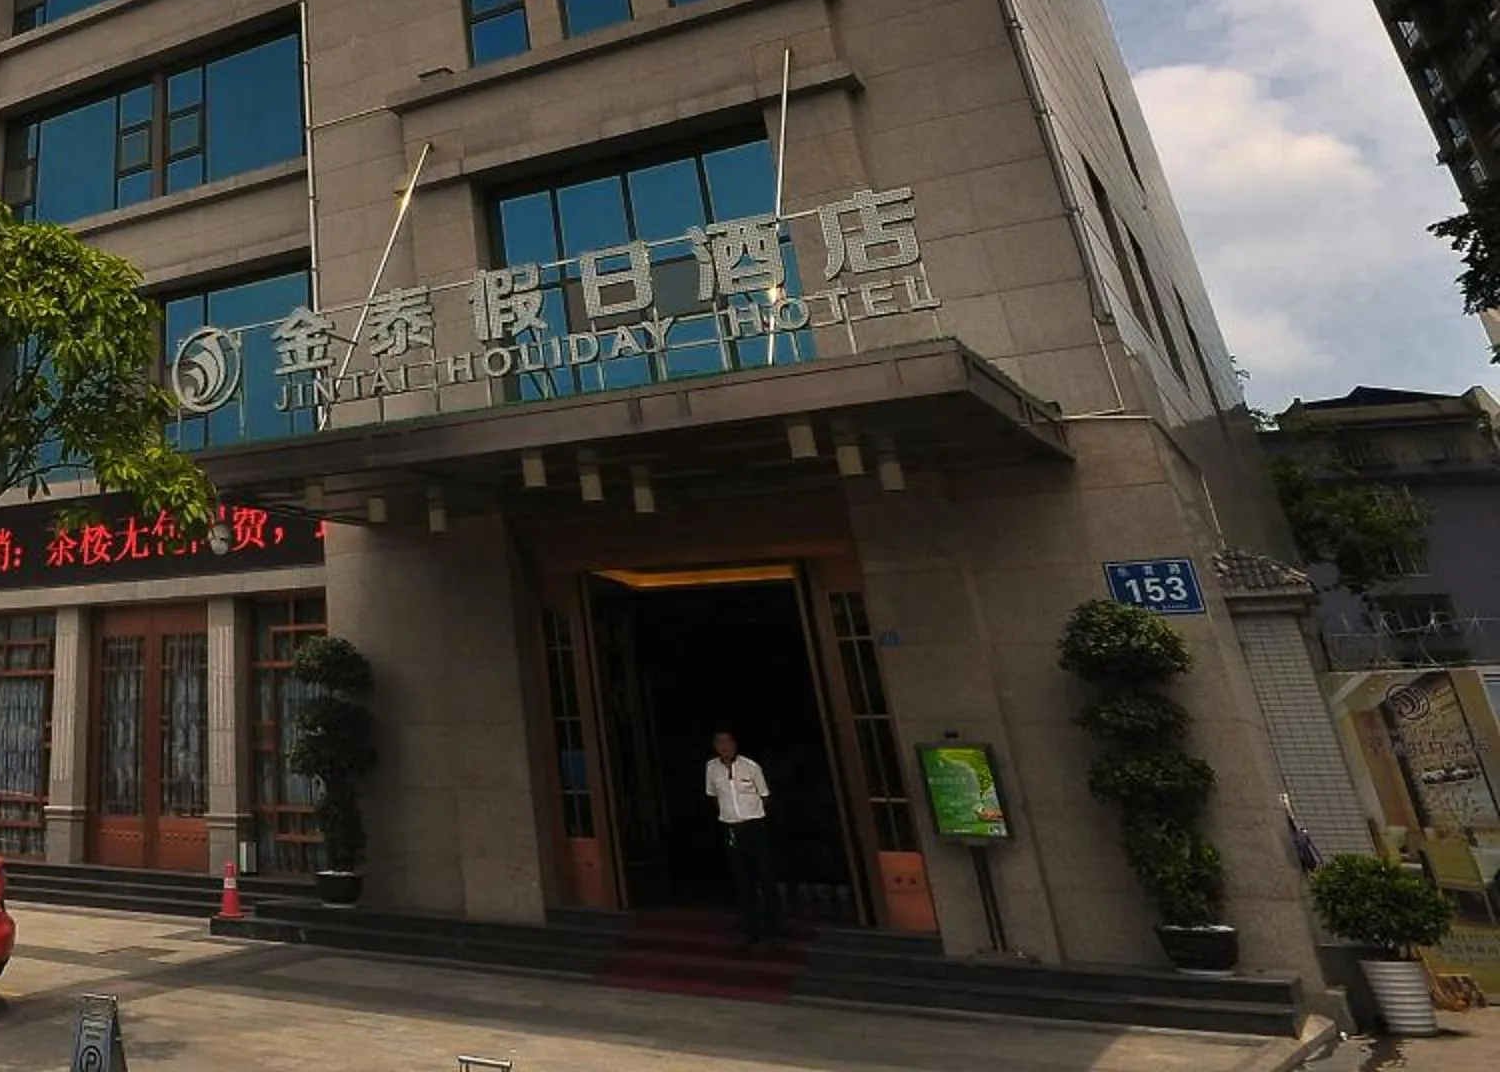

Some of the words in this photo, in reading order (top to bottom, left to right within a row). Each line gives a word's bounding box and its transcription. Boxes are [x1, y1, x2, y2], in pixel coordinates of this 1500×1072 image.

[270, 187, 920, 376] 金泰假日酒店
[274, 362, 411, 413] JINTAI
[447, 315, 676, 383] HOLIDAY
[727, 275, 942, 338] HOTEL
[1124, 576, 1189, 603] 153
